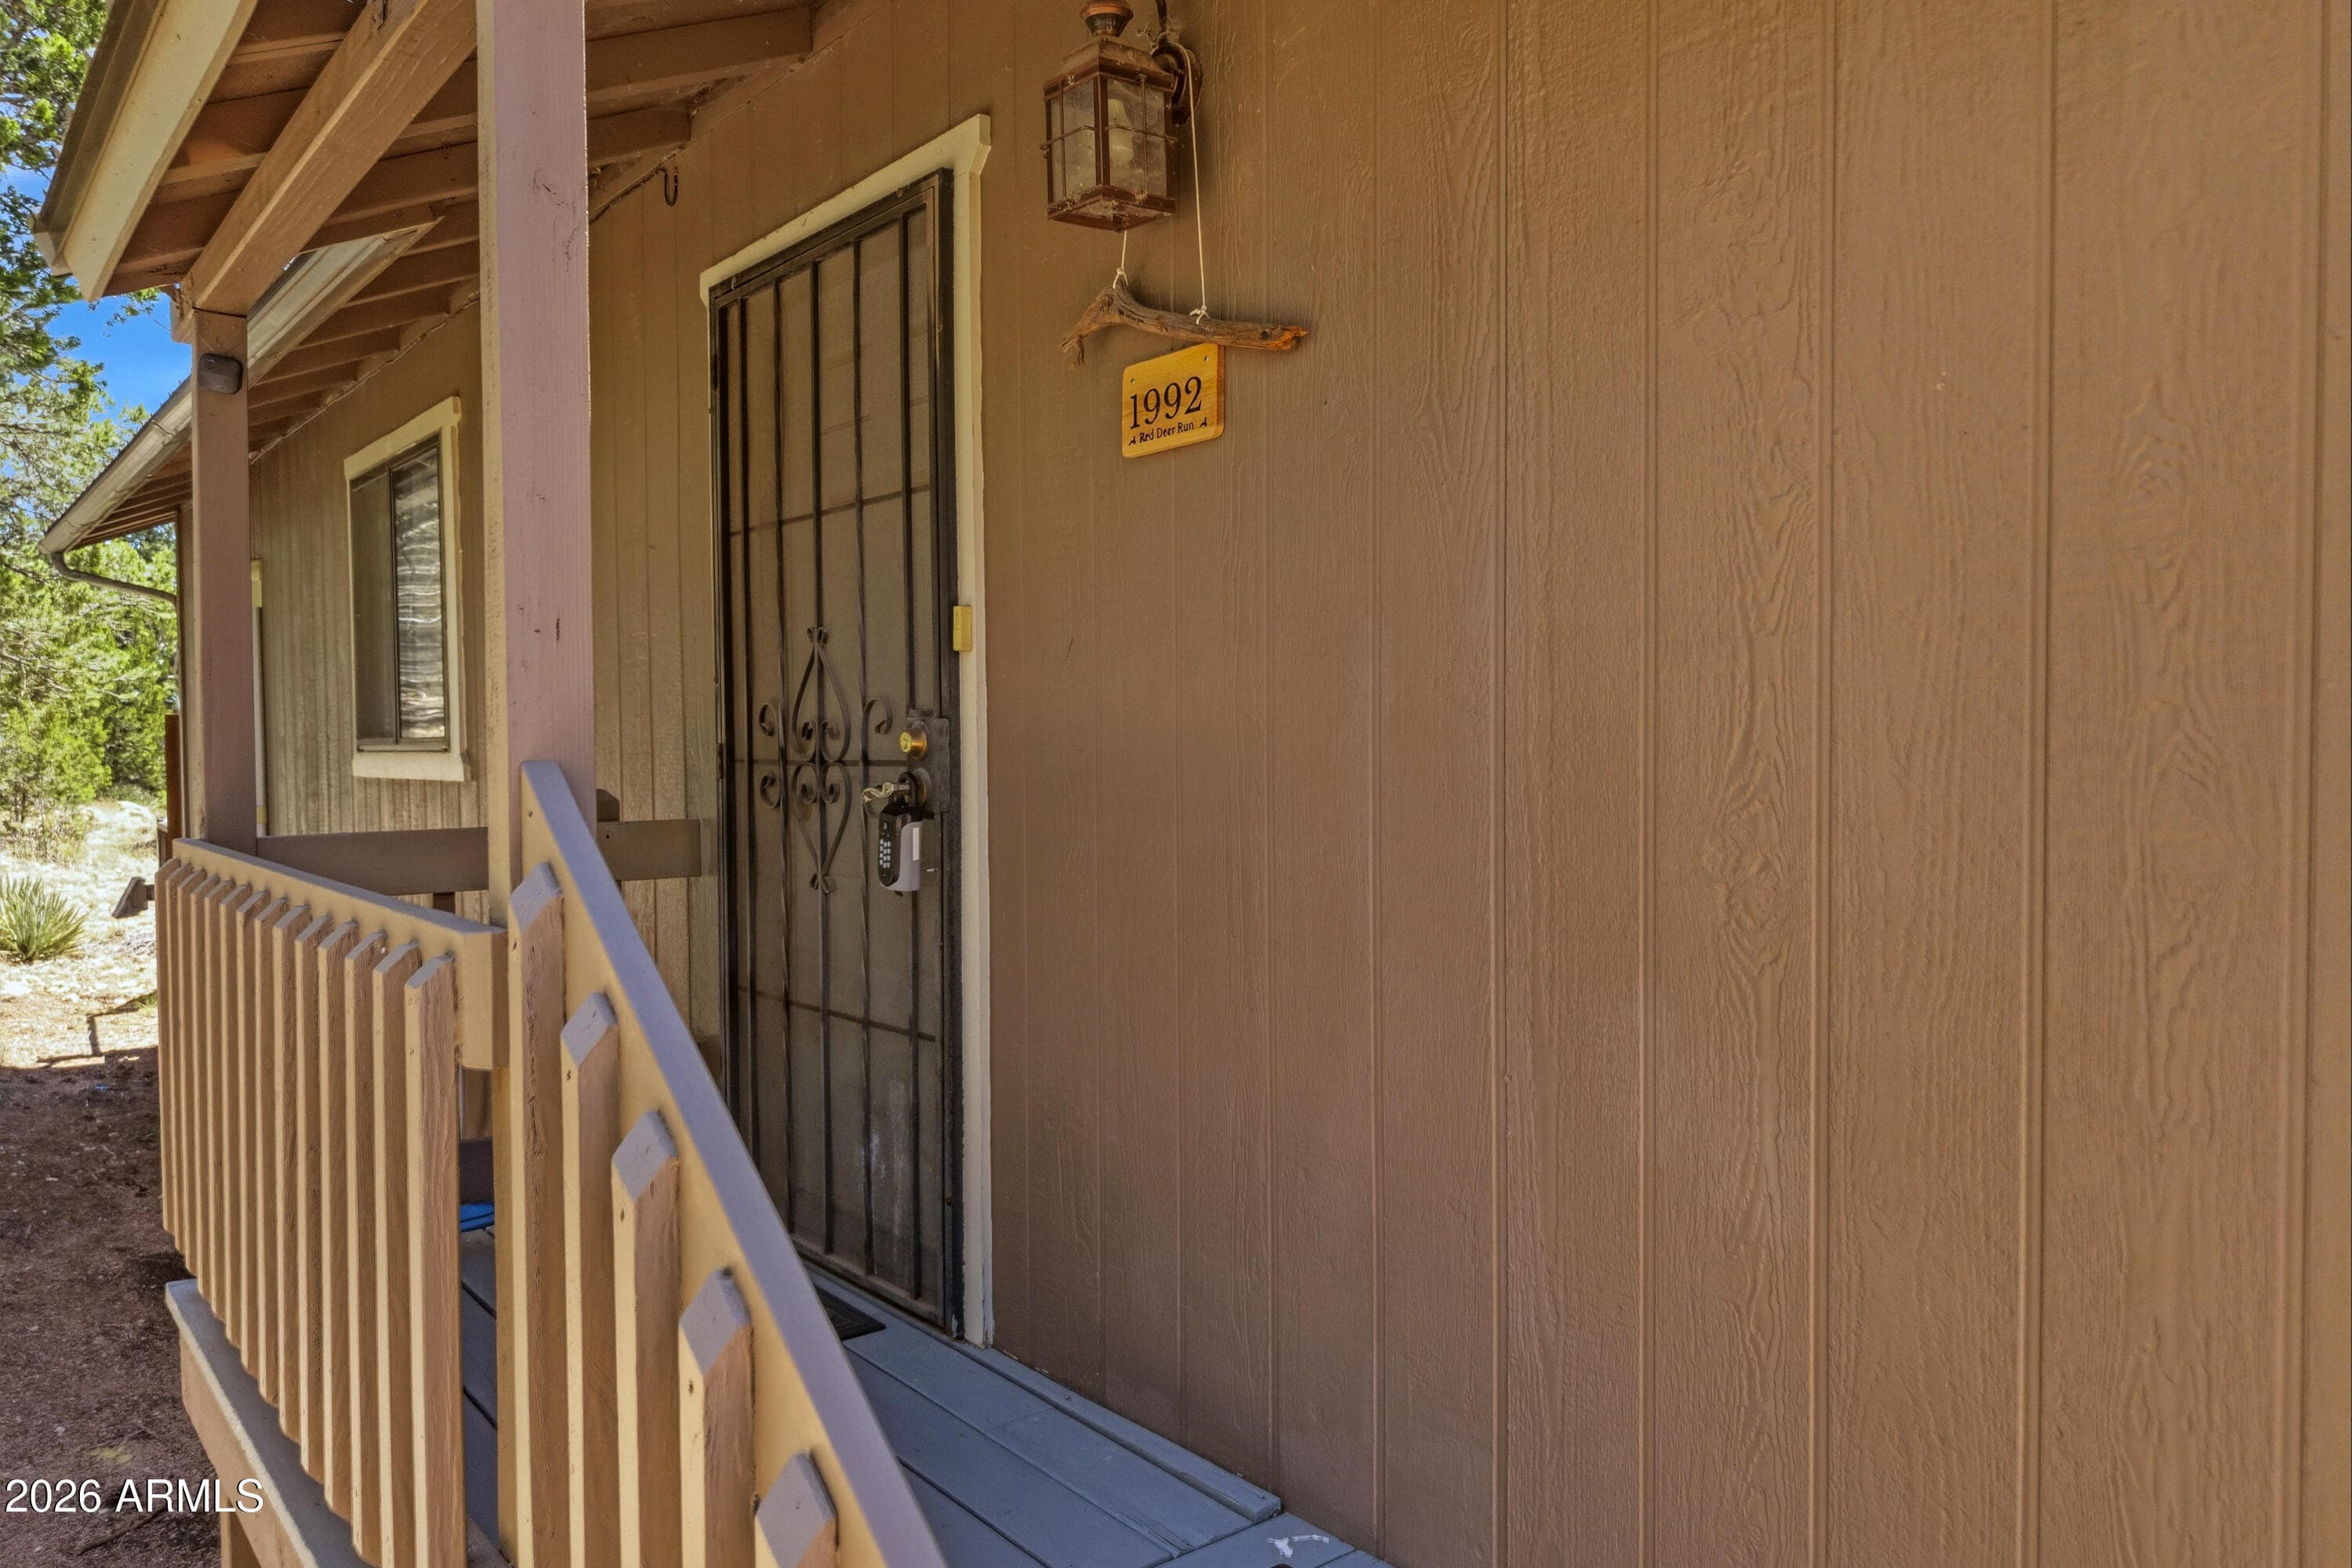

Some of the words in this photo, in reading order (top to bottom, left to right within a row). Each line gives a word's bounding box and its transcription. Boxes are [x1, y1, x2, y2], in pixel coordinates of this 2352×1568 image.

[1131, 376, 1202, 429] 1992
[1139, 429, 1154, 444] Red
[1156, 426, 1175, 438] Deer
[1178, 422, 1194, 434] Run
